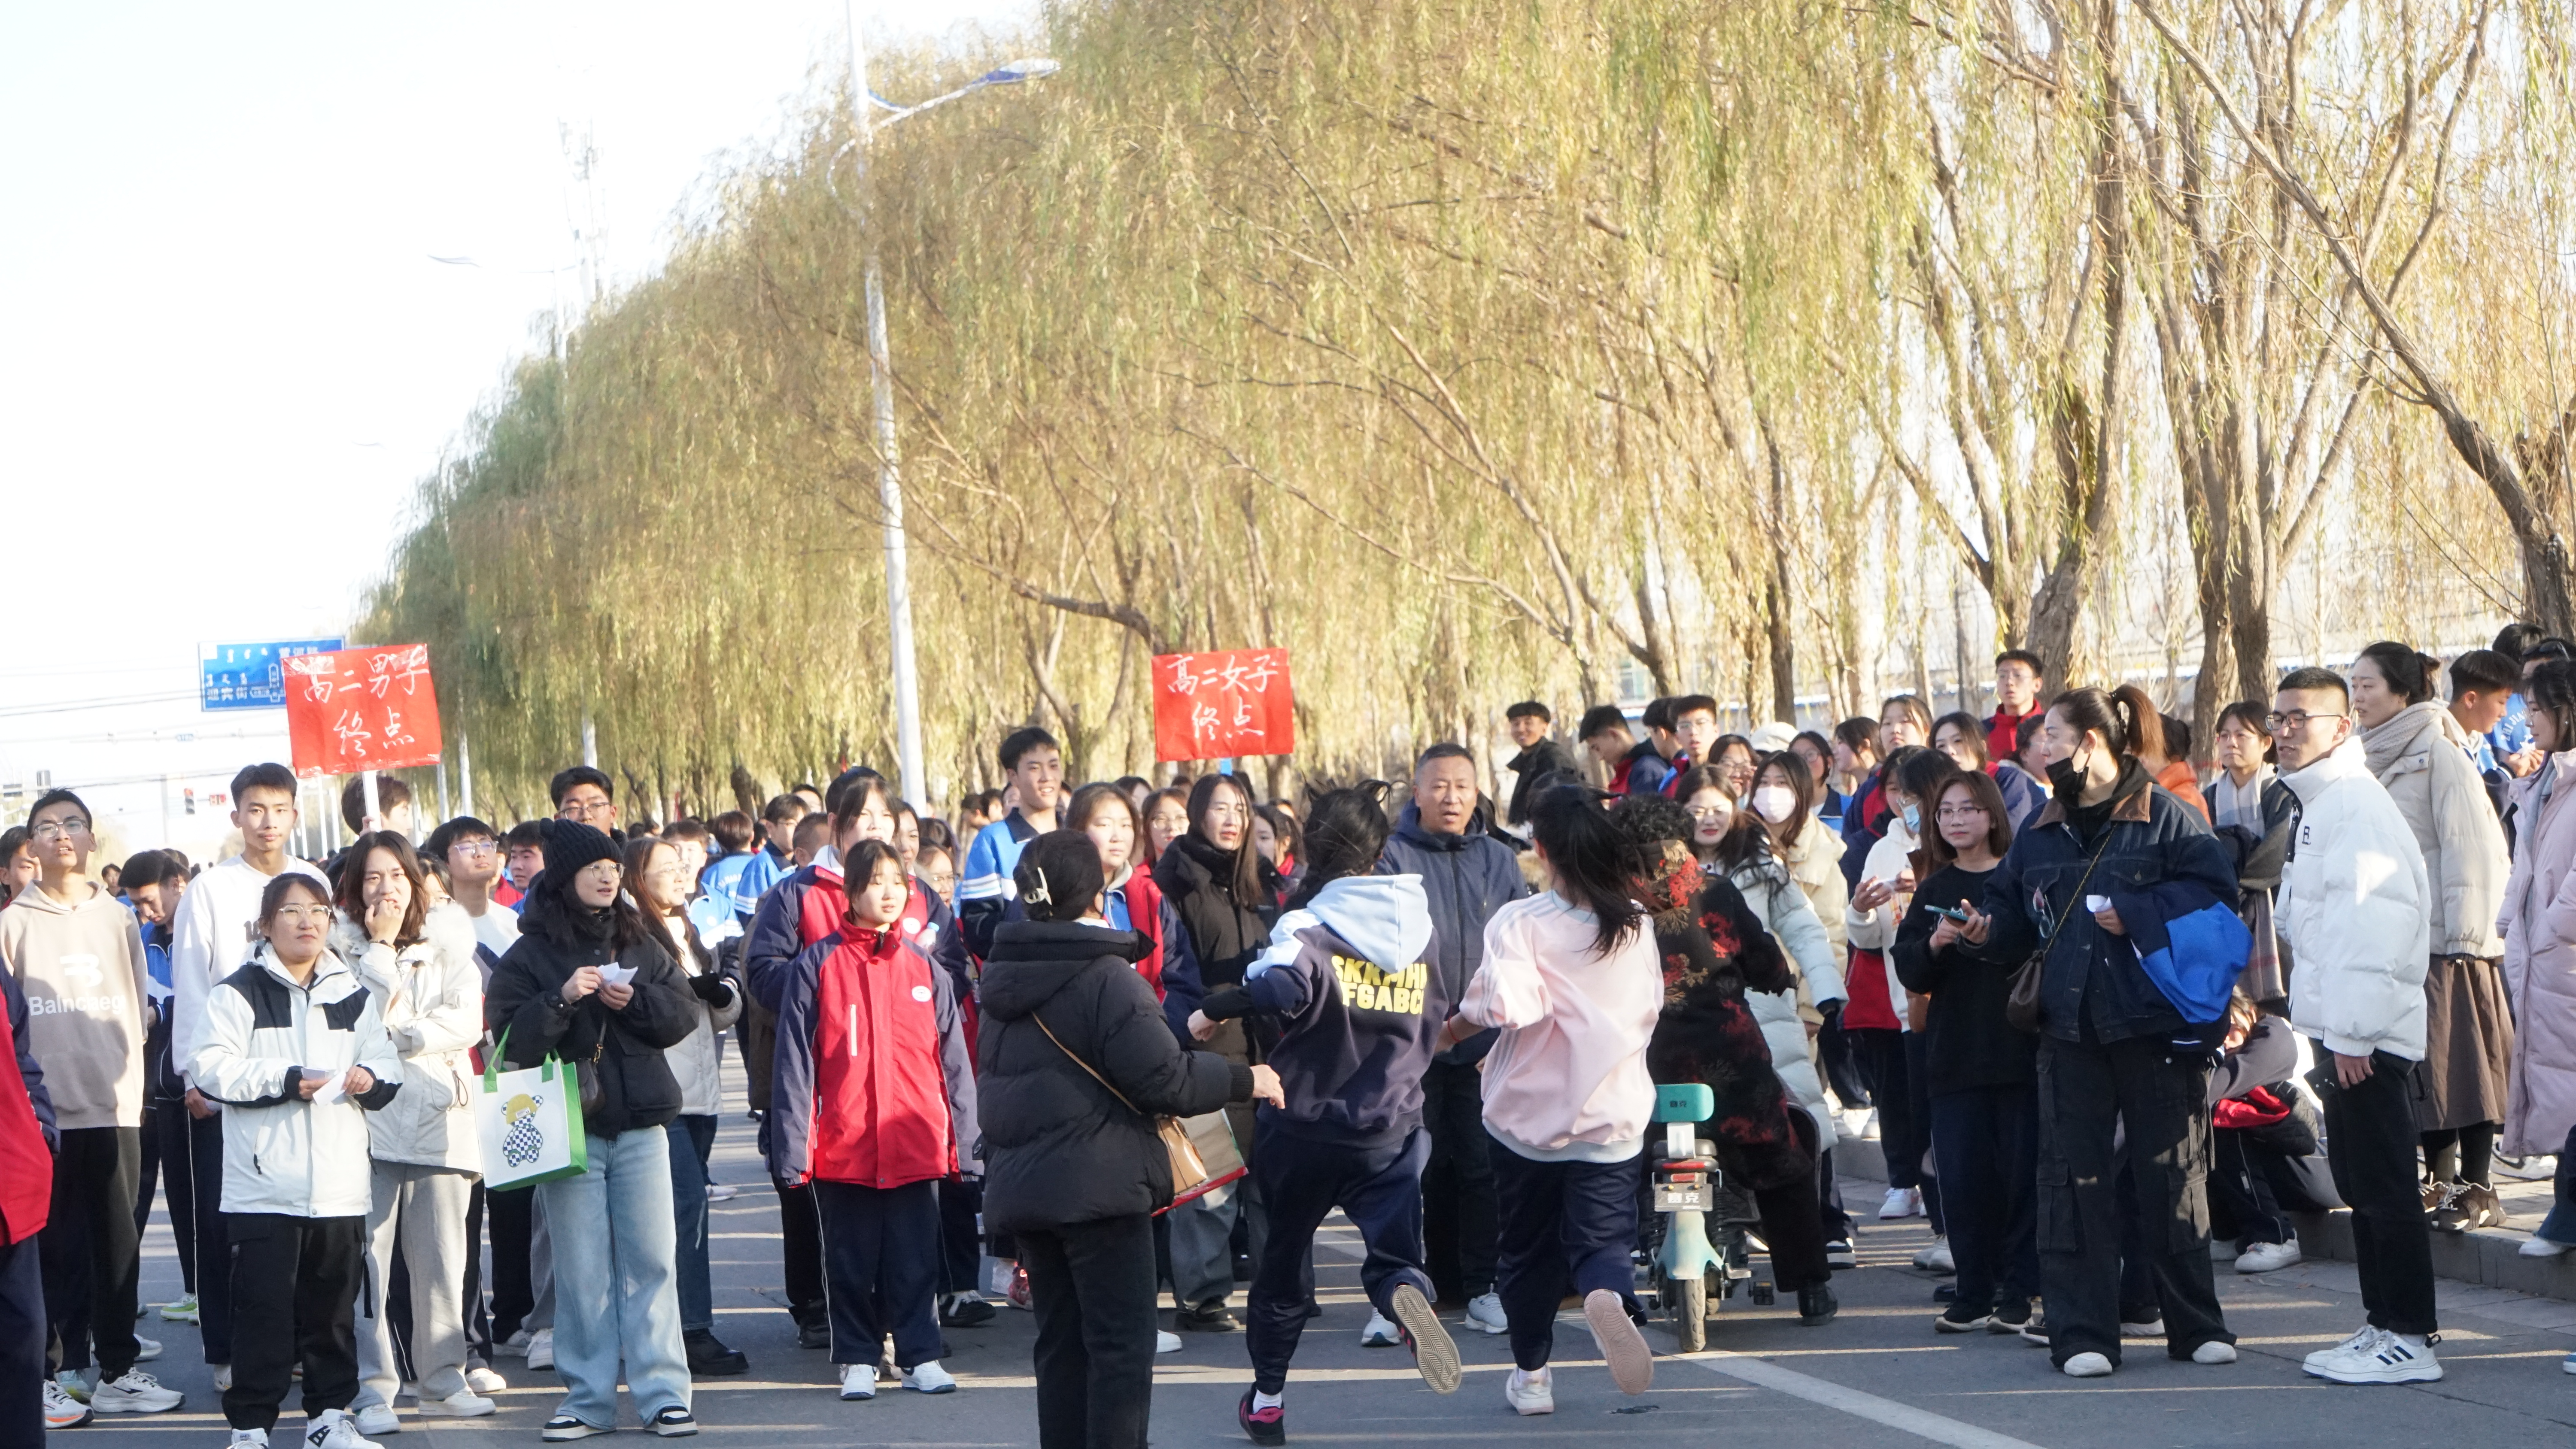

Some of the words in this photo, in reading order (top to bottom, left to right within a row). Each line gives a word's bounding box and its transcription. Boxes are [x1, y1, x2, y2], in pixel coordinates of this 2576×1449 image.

[297, 645, 429, 703] 高二男子
[1167, 655, 1278, 695] 高二女子
[333, 706, 415, 758] 终点
[1191, 696, 1265, 740] 终点
